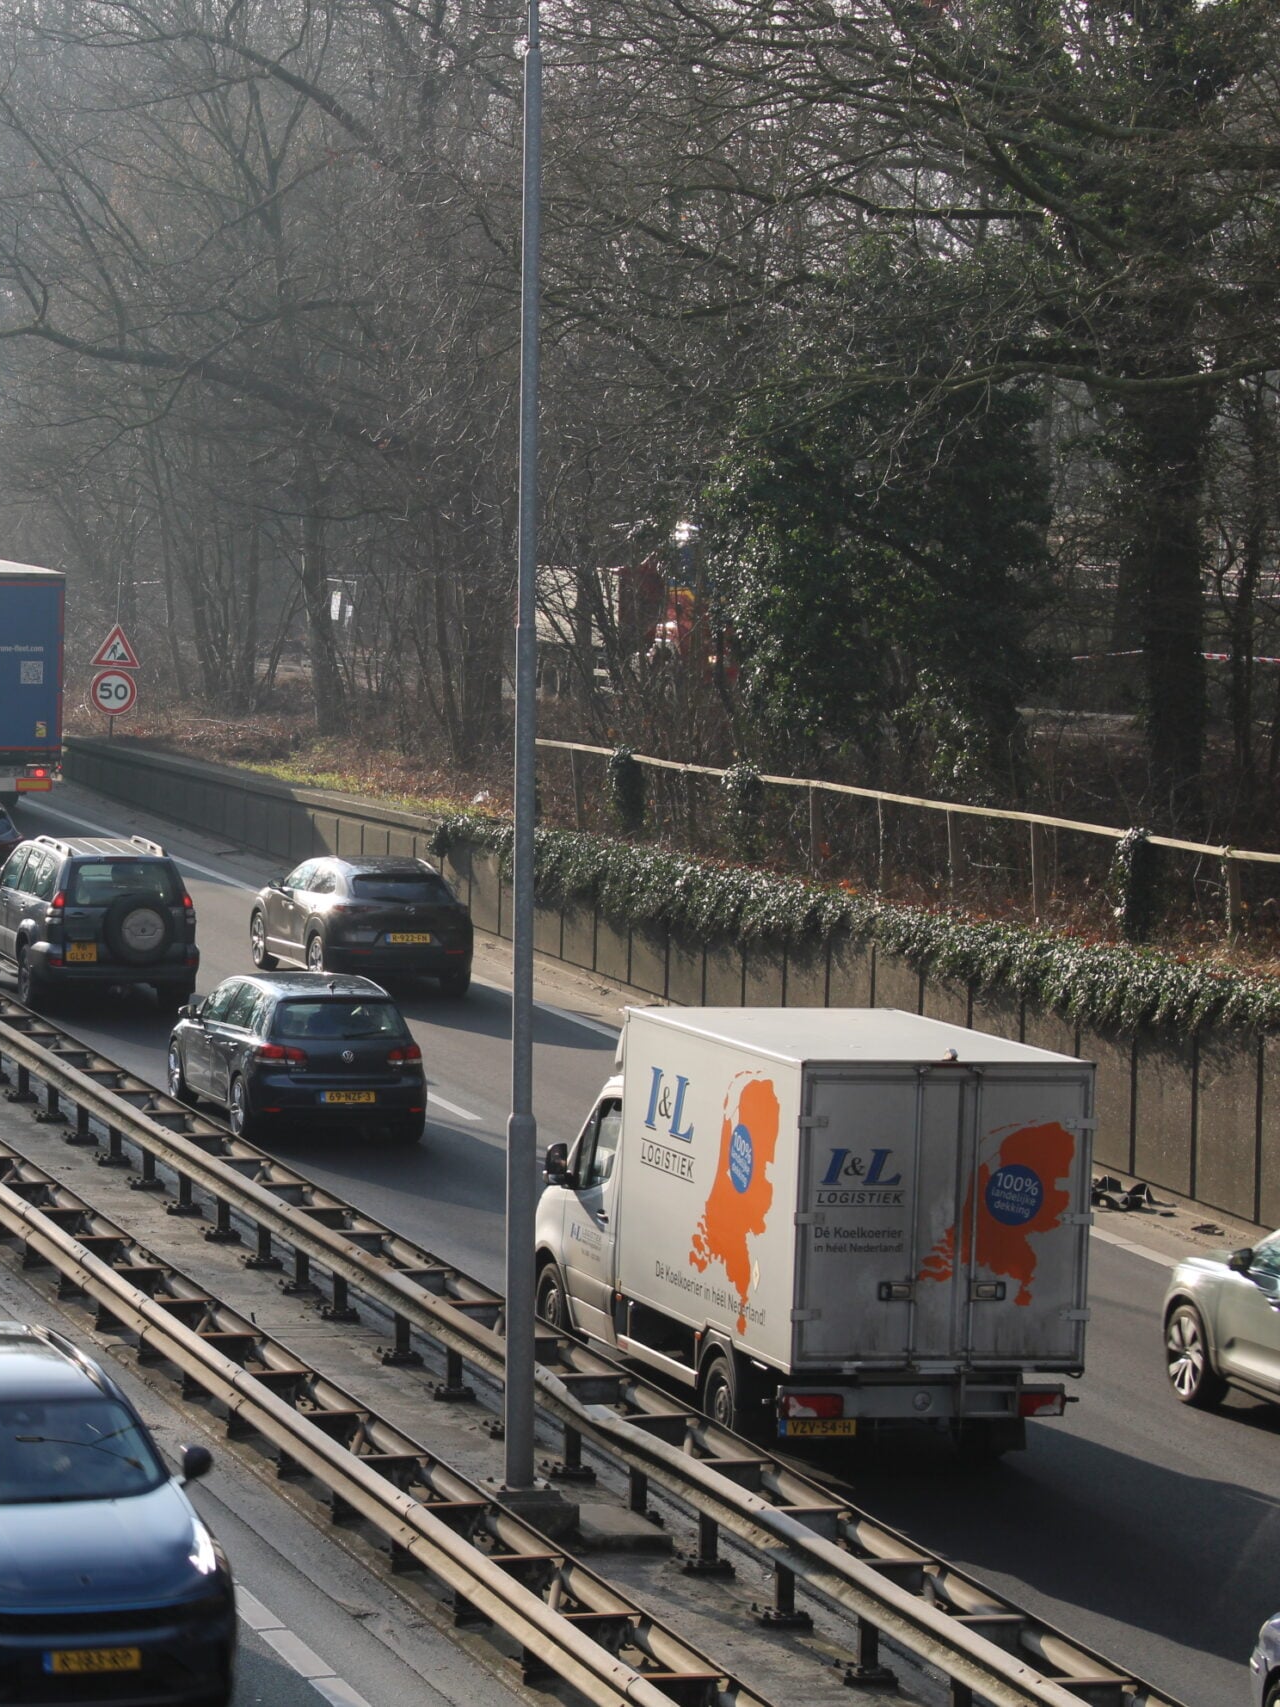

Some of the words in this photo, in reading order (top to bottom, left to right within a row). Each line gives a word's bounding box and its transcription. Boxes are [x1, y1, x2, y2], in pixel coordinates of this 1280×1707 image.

[99, 683, 128, 700] 50
[329, 1092, 372, 1102] 69-NZF-3
[644, 1066, 695, 1144] I&L
[733, 1131, 752, 1165] 100%
[641, 1142, 695, 1178] LOGISTIEK
[820, 1148, 902, 1186] I&L
[996, 1172, 1039, 1196] 100%
[817, 1192, 903, 1204] LOGISTIEK
[991, 1186, 1037, 1207] landelijke
[993, 1200, 1031, 1218] dekking
[814, 1226, 830, 1239] Dé
[834, 1226, 904, 1239] Koelkoerier
[814, 1243, 824, 1253] in
[850, 1243, 905, 1253] Nederland!
[655, 1260, 665, 1280] Dé
[665, 1265, 703, 1297] Koelkoerier
[704, 1281, 711, 1301] in
[711, 1286, 727, 1309] héél
[728, 1293, 767, 1326] Nederland!
